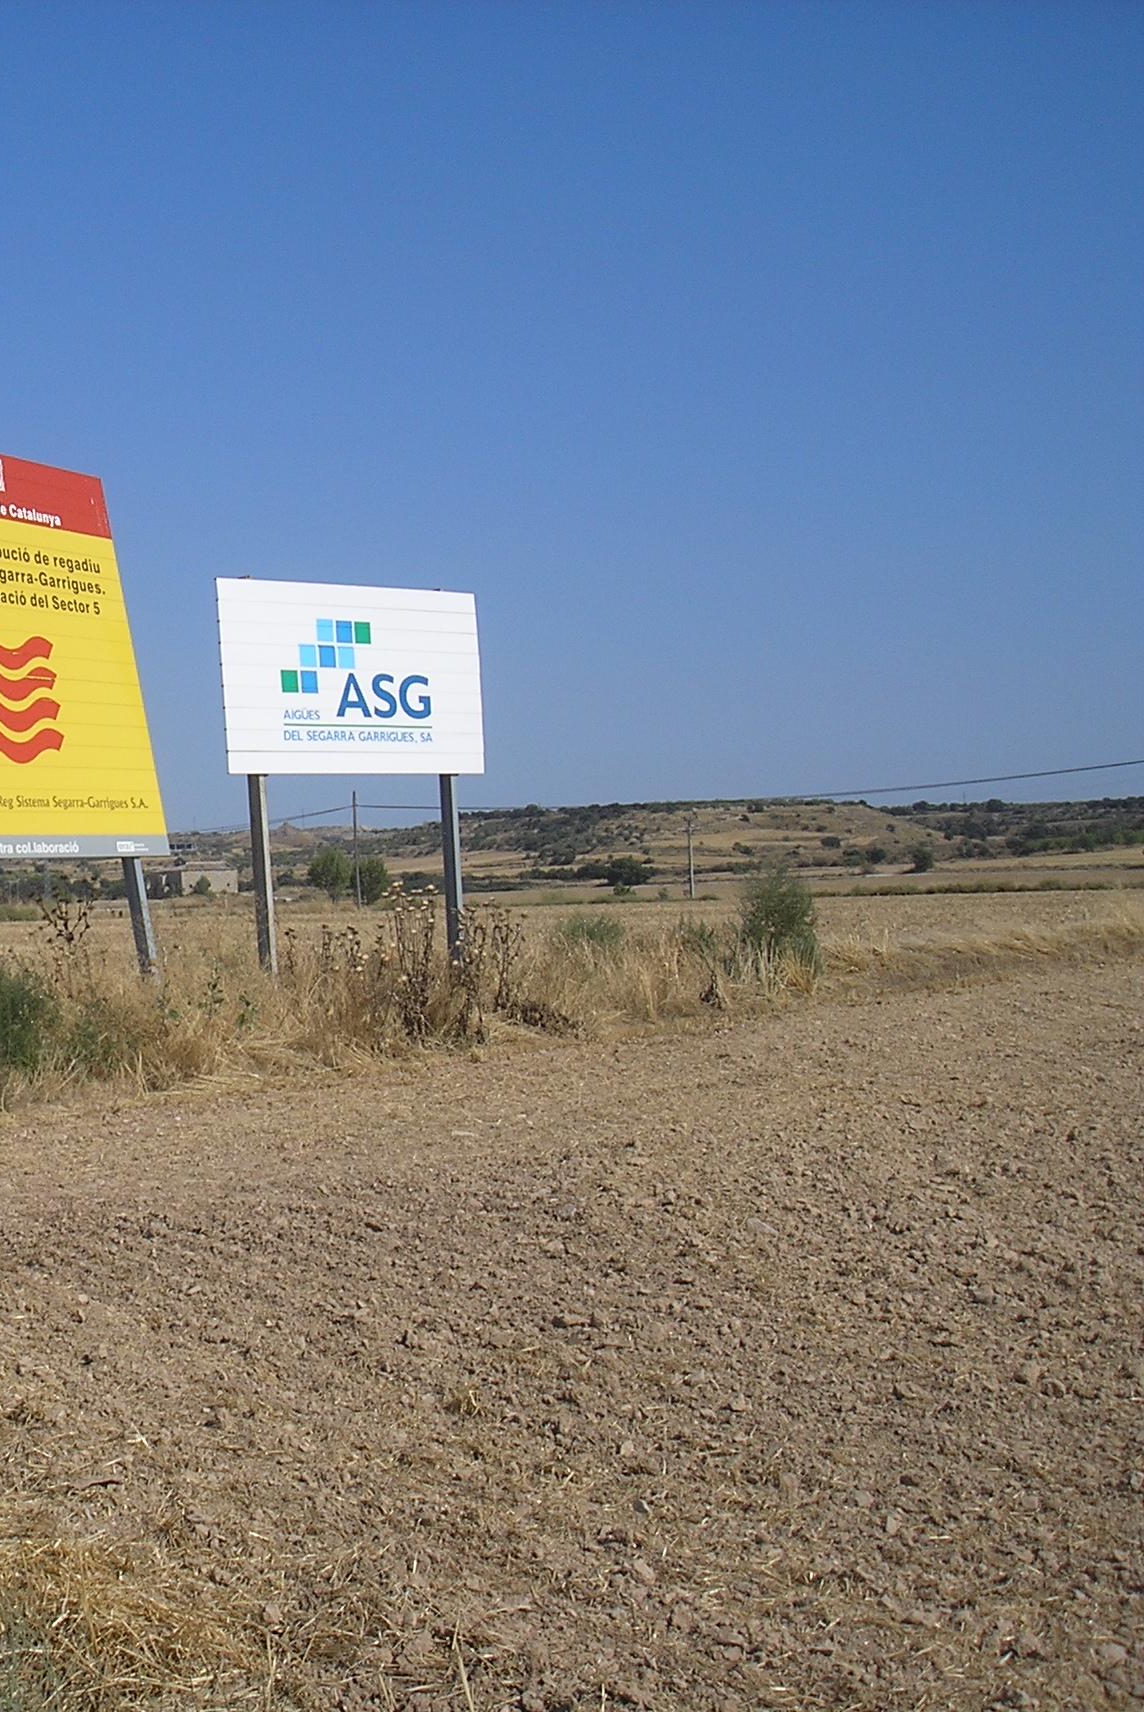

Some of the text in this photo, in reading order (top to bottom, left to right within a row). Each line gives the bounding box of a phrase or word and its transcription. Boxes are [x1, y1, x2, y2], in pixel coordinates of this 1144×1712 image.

[9, 504, 62, 527] Catalunya
[34, 550, 49, 565] de
[53, 556, 101, 573] regadiu
[30, 593, 49, 608] del
[51, 595, 90, 614] Sector
[92, 601, 101, 615] 5
[336, 672, 432, 720] ASG
[283, 707, 321, 721] AIGÜES
[283, 730, 433, 744] DEL SEGARRA GARRIGUES, SA
[16, 795, 51, 808] Sistema
[52, 796, 129, 810] Segarra-Garrigues
[130, 796, 149, 809] S.A.
